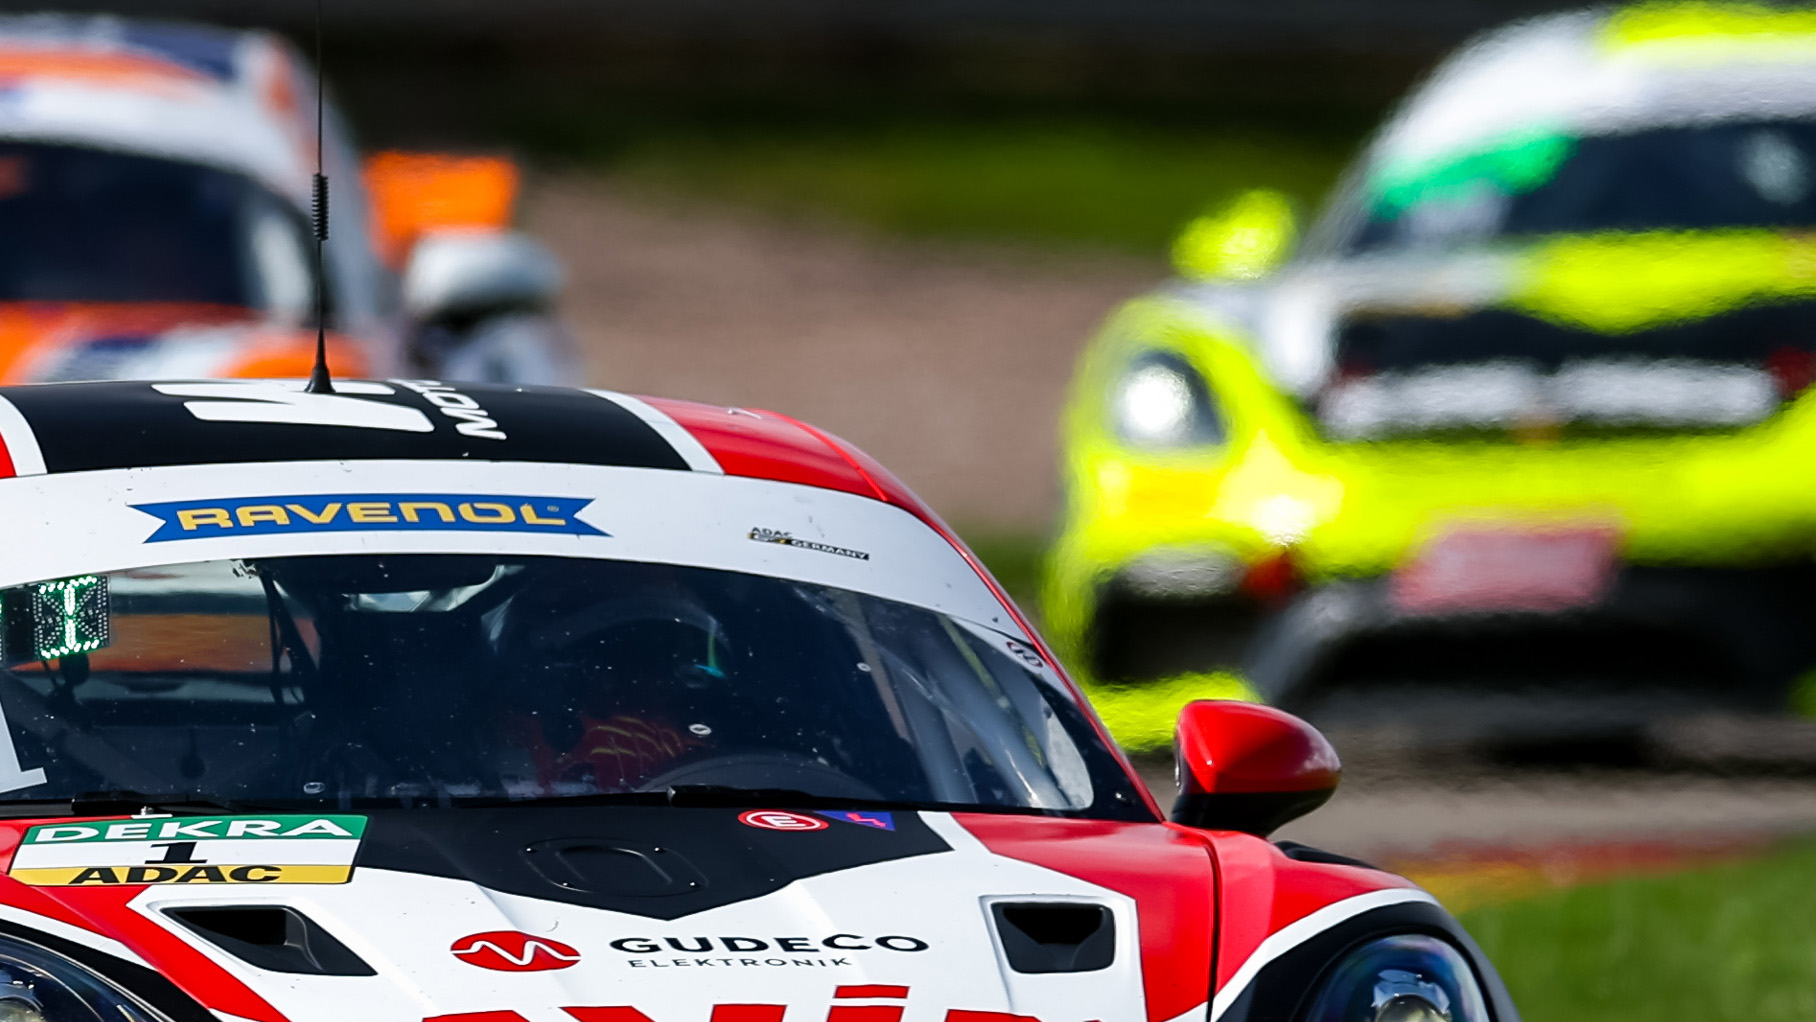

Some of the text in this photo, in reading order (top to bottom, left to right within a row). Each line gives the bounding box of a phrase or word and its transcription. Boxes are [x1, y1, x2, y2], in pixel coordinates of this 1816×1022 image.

[175, 502, 567, 532] RAVENOL
[791, 538, 867, 560] GERMANY
[33, 818, 355, 842] DEKRA
[144, 841, 210, 865] 1
[66, 865, 284, 885] ADAC
[609, 933, 931, 954] GUDECO
[627, 956, 854, 969] ELEKTRONIK
